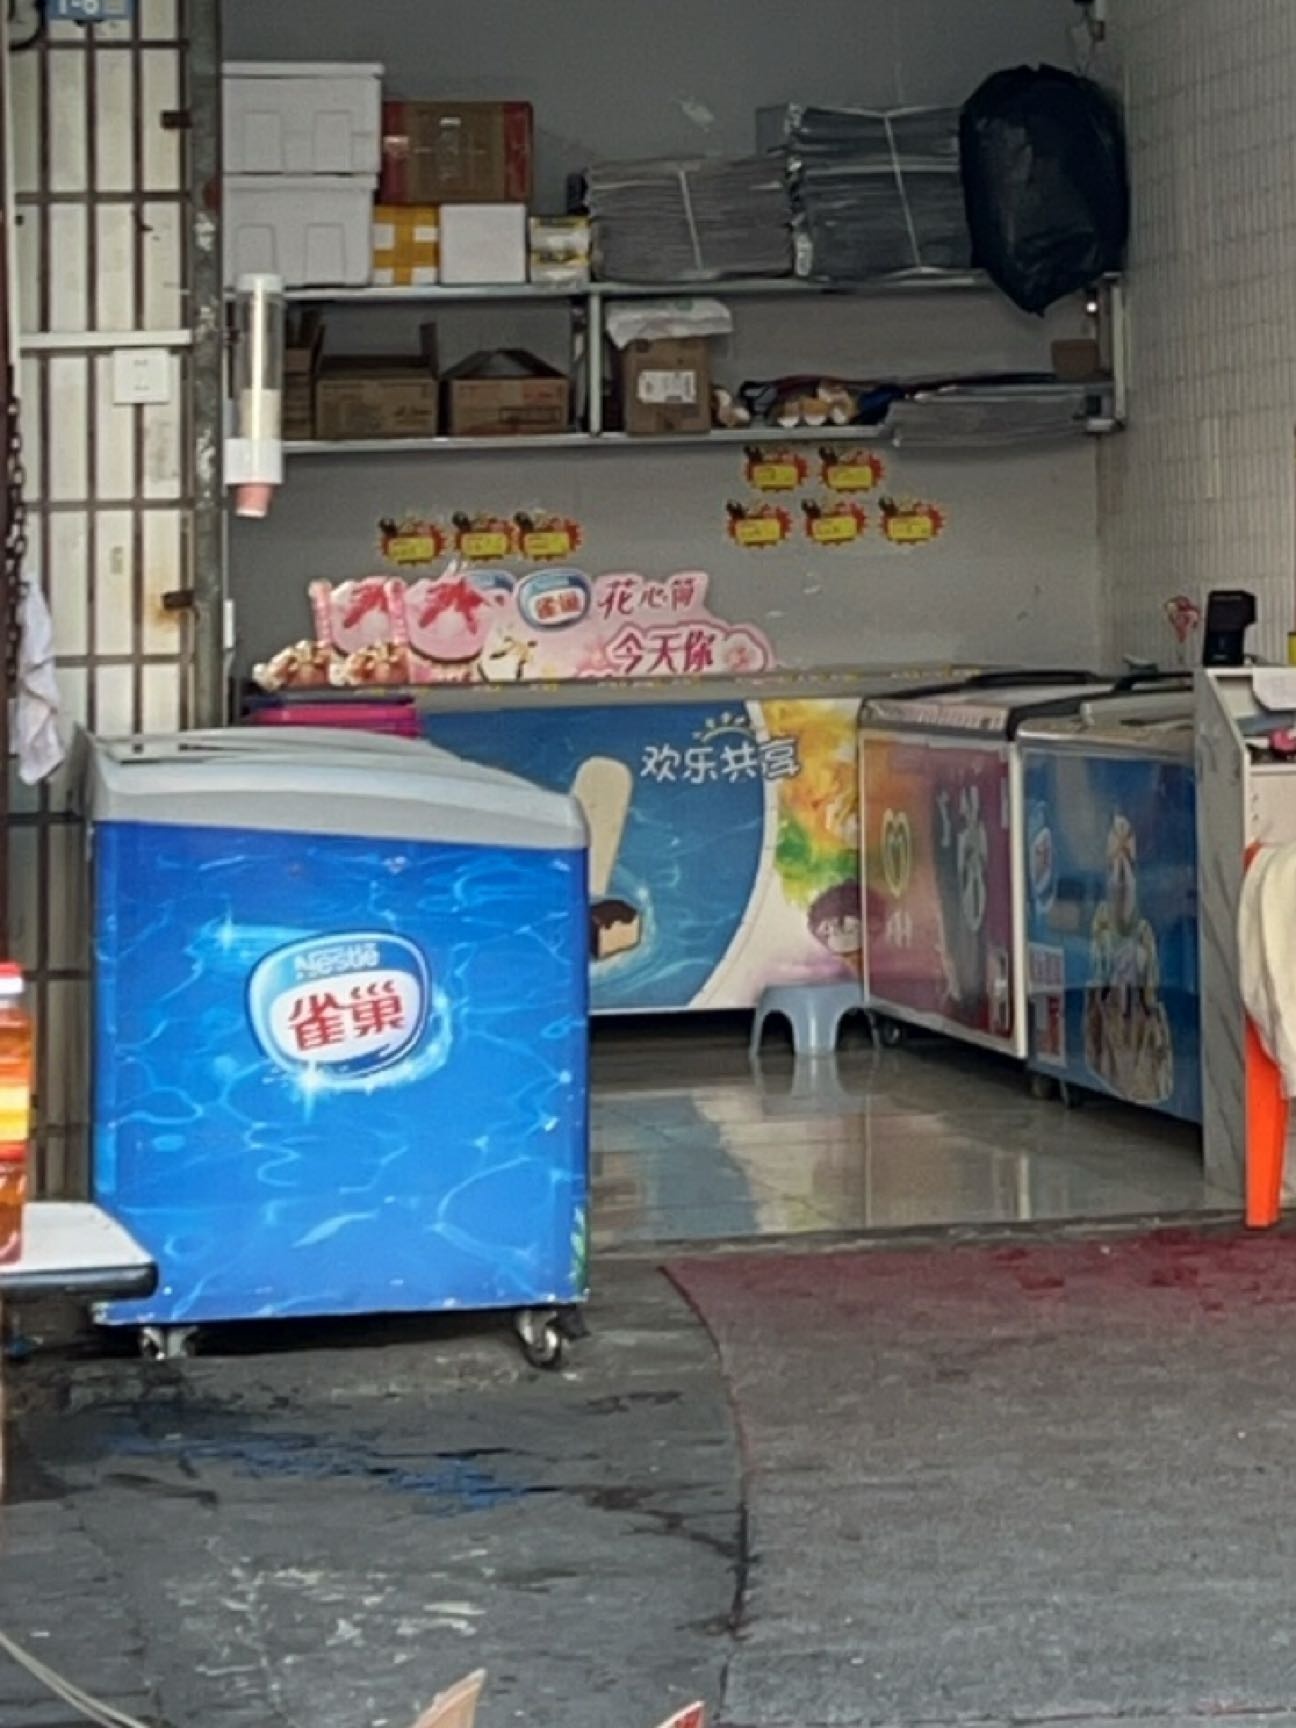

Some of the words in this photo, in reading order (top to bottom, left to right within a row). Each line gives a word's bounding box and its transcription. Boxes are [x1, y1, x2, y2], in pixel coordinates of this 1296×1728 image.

[640, 739, 801, 784] 欢乐共享
[287, 979, 405, 1051] 雀巢
